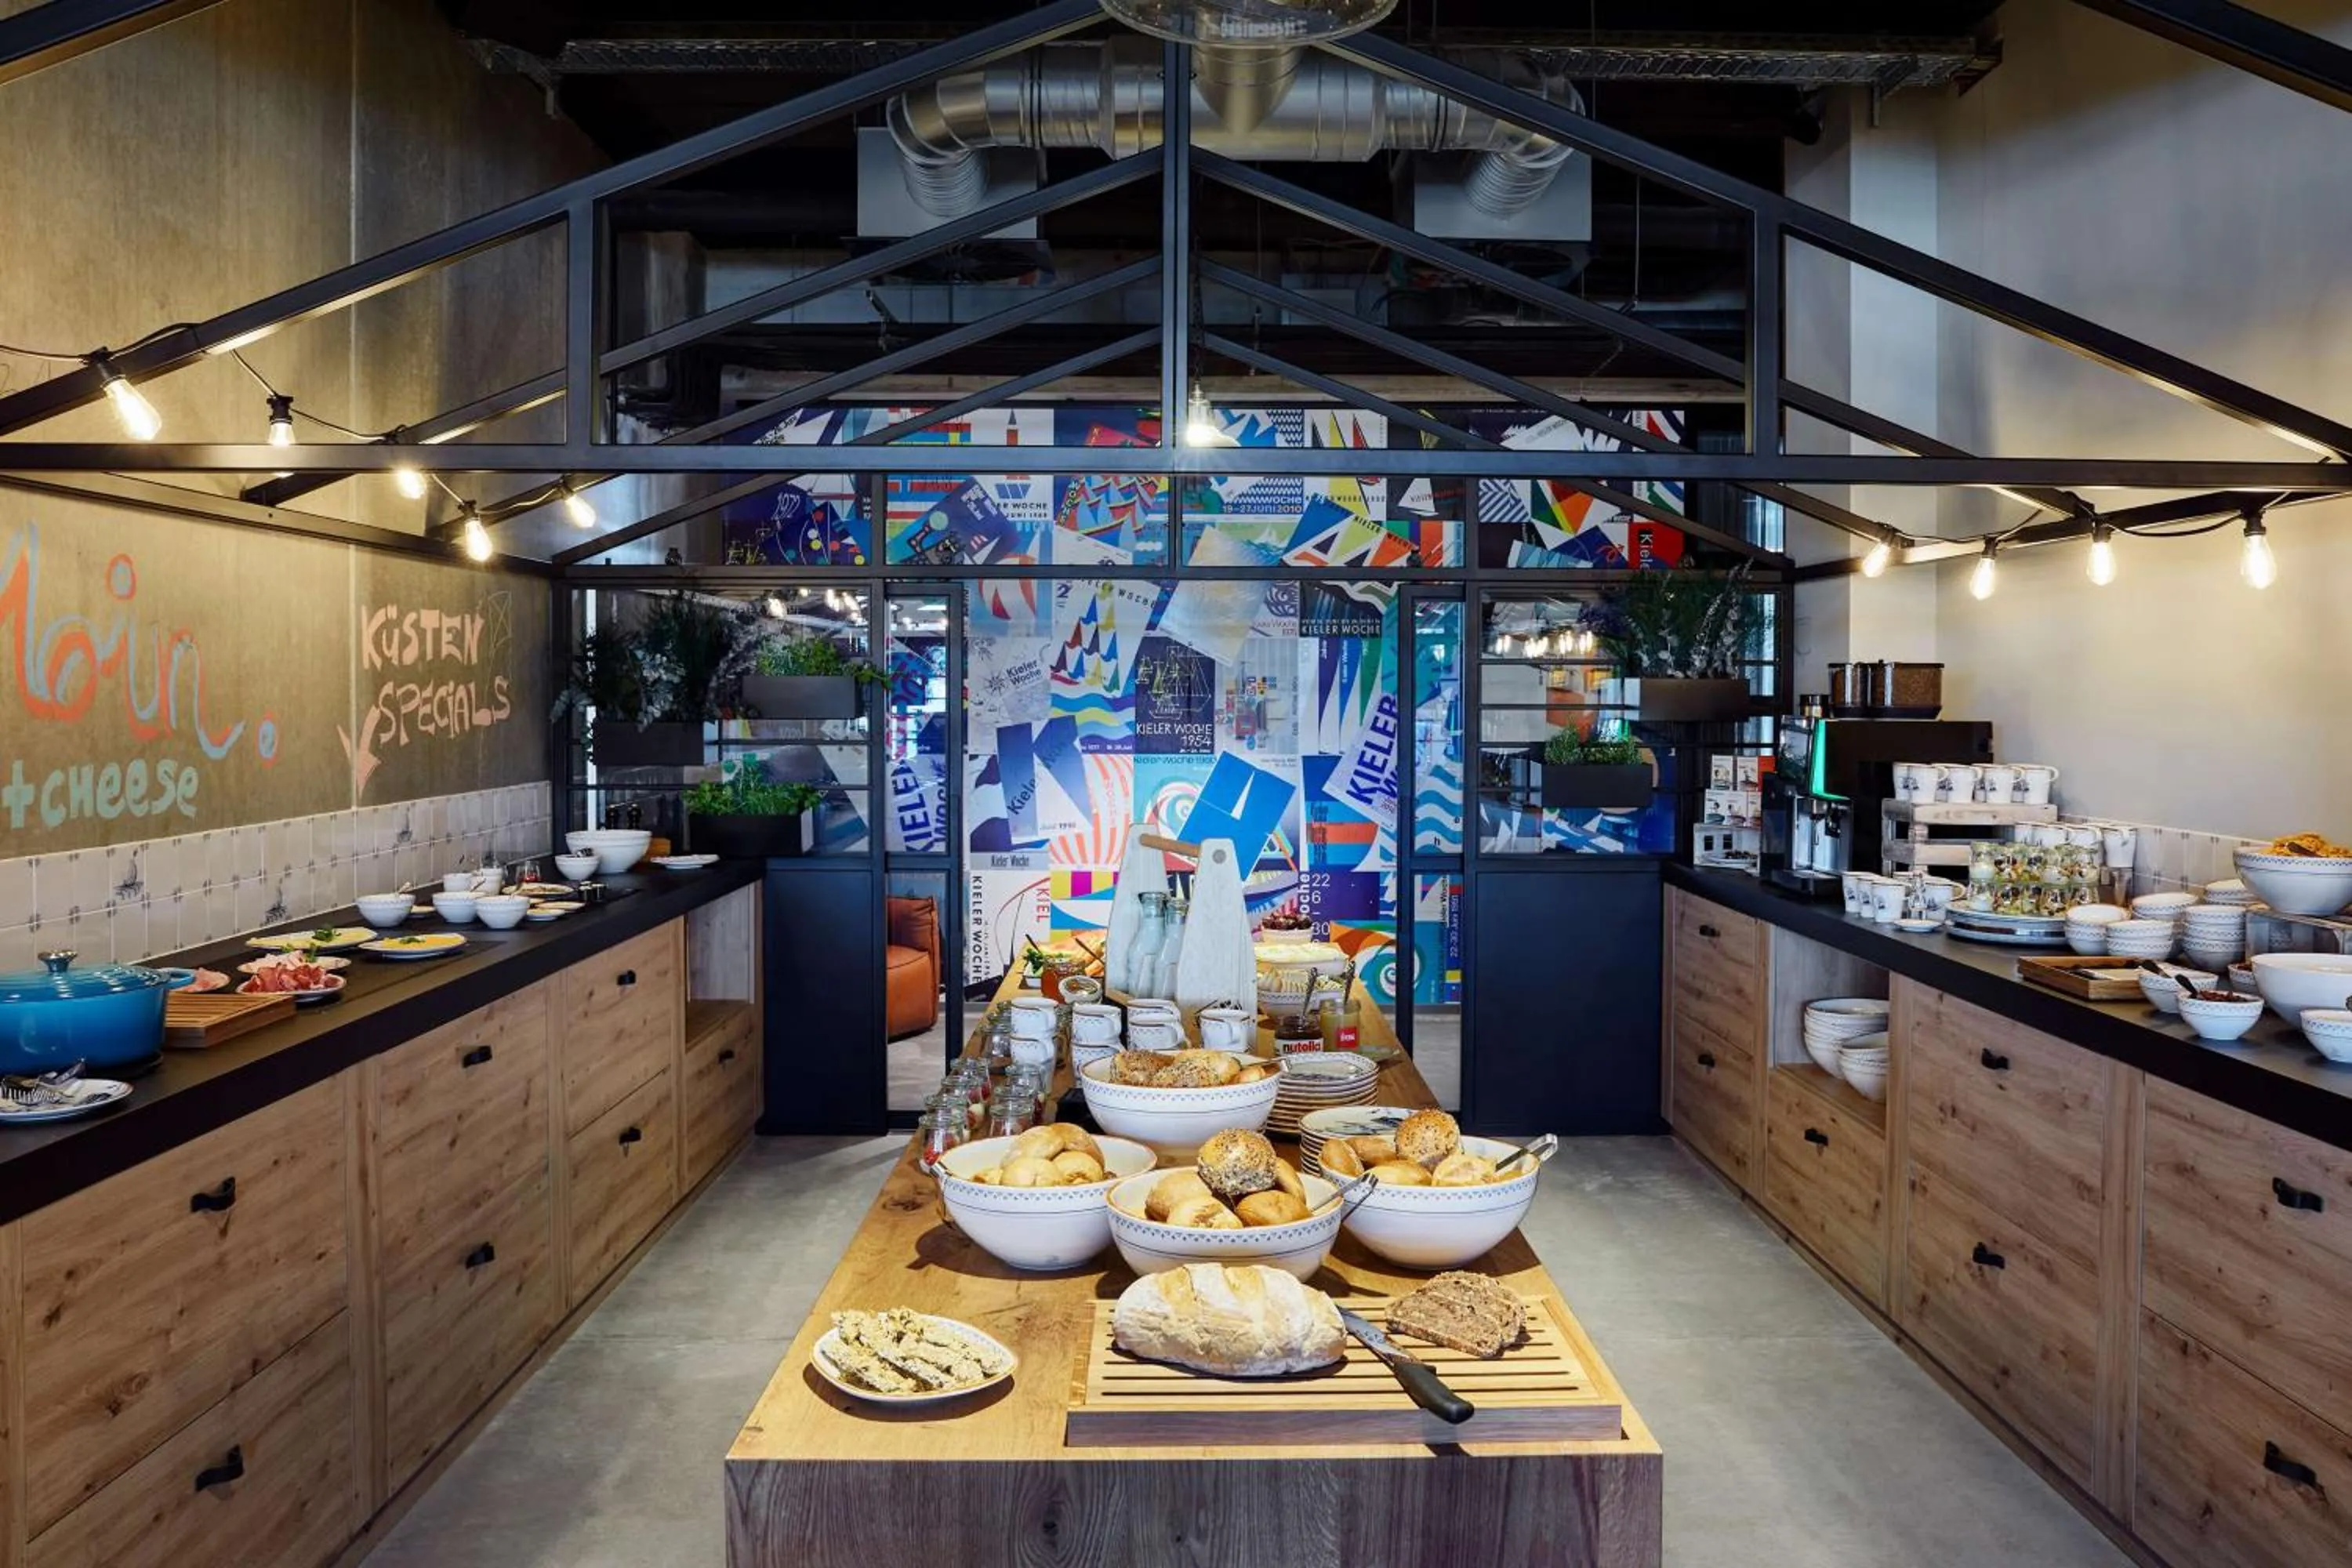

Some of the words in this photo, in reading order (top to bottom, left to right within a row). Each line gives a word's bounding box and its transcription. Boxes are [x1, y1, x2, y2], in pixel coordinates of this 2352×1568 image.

[1006, 660, 1037, 677] Kieler
[1136, 722, 1172, 735] KIELER
[1174, 723, 1213, 735] WOCHE
[1312, 873, 1330, 887] 22
[972, 876, 982, 925] KIELER
[1036, 888, 1050, 922] KIEL
[1283, 1040, 1321, 1053] nutella
